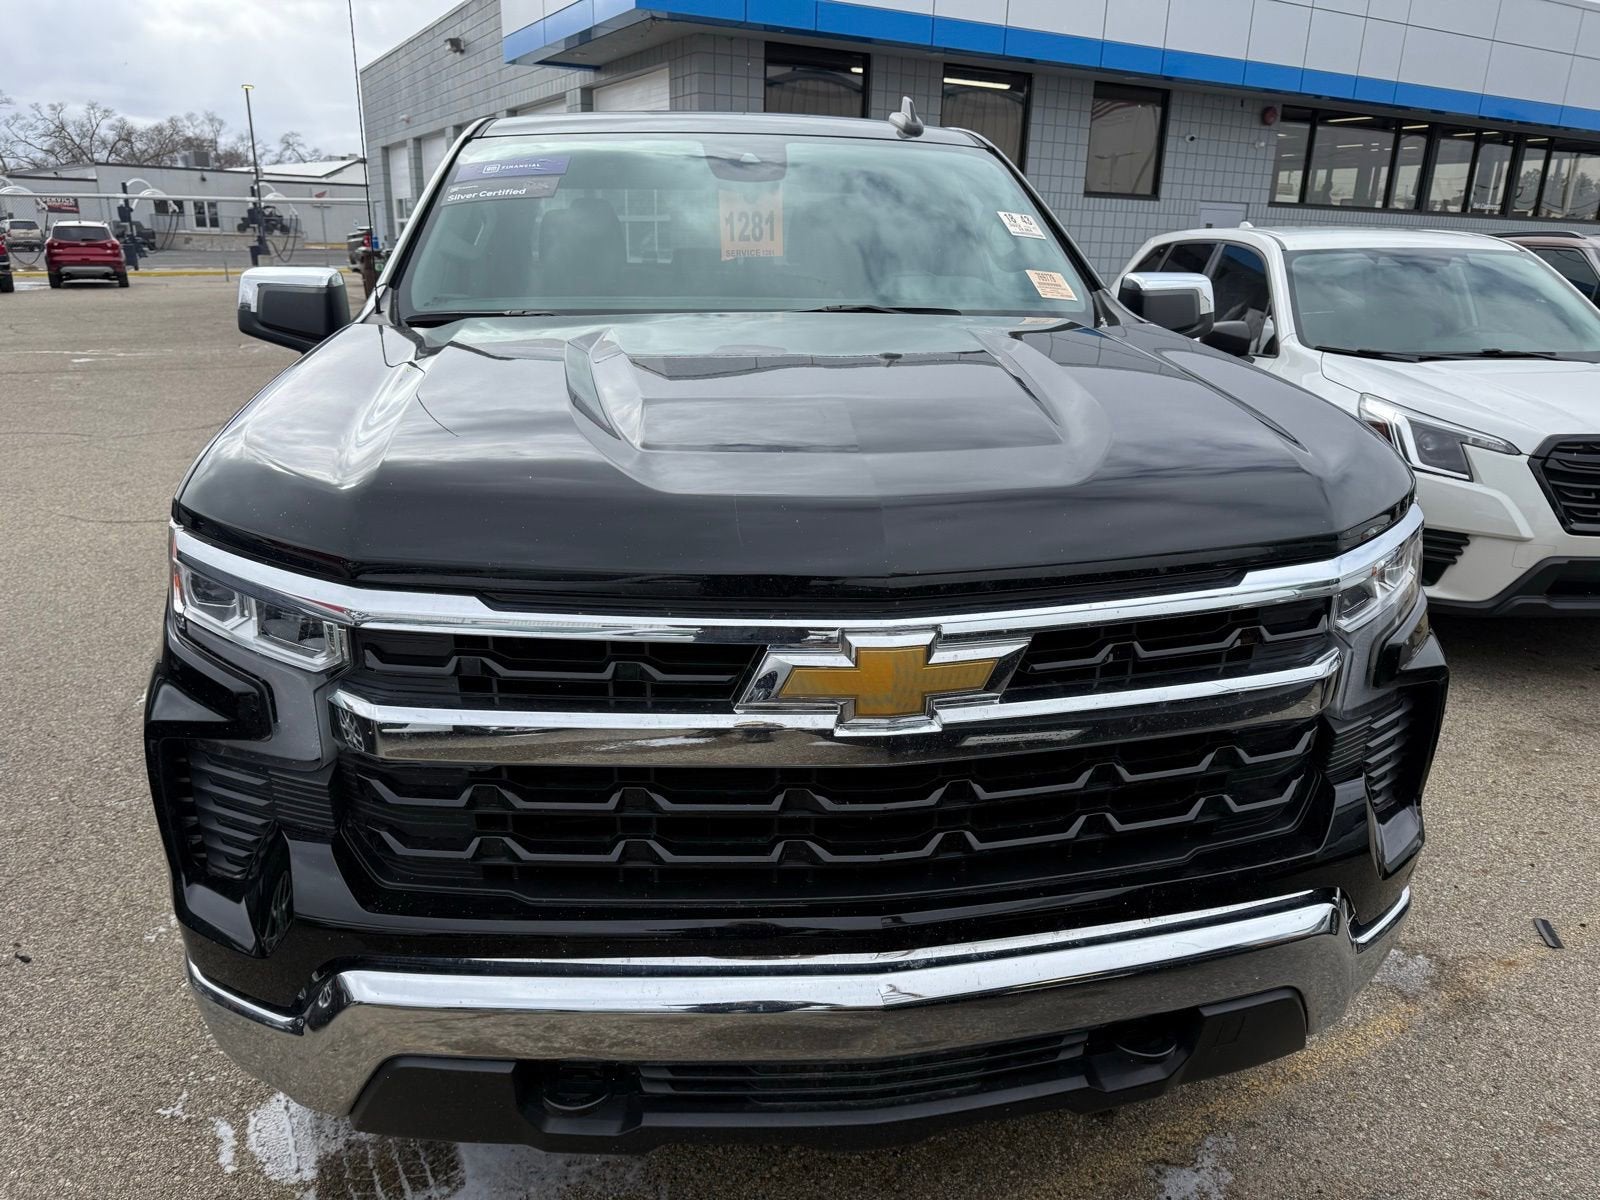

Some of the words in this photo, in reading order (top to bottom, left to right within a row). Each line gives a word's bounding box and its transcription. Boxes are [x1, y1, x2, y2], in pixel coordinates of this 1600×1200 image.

[447, 191, 478, 202] Silver
[479, 188, 527, 198] Certified
[725, 210, 775, 242] 1281
[725, 249, 761, 257] SERVICE
